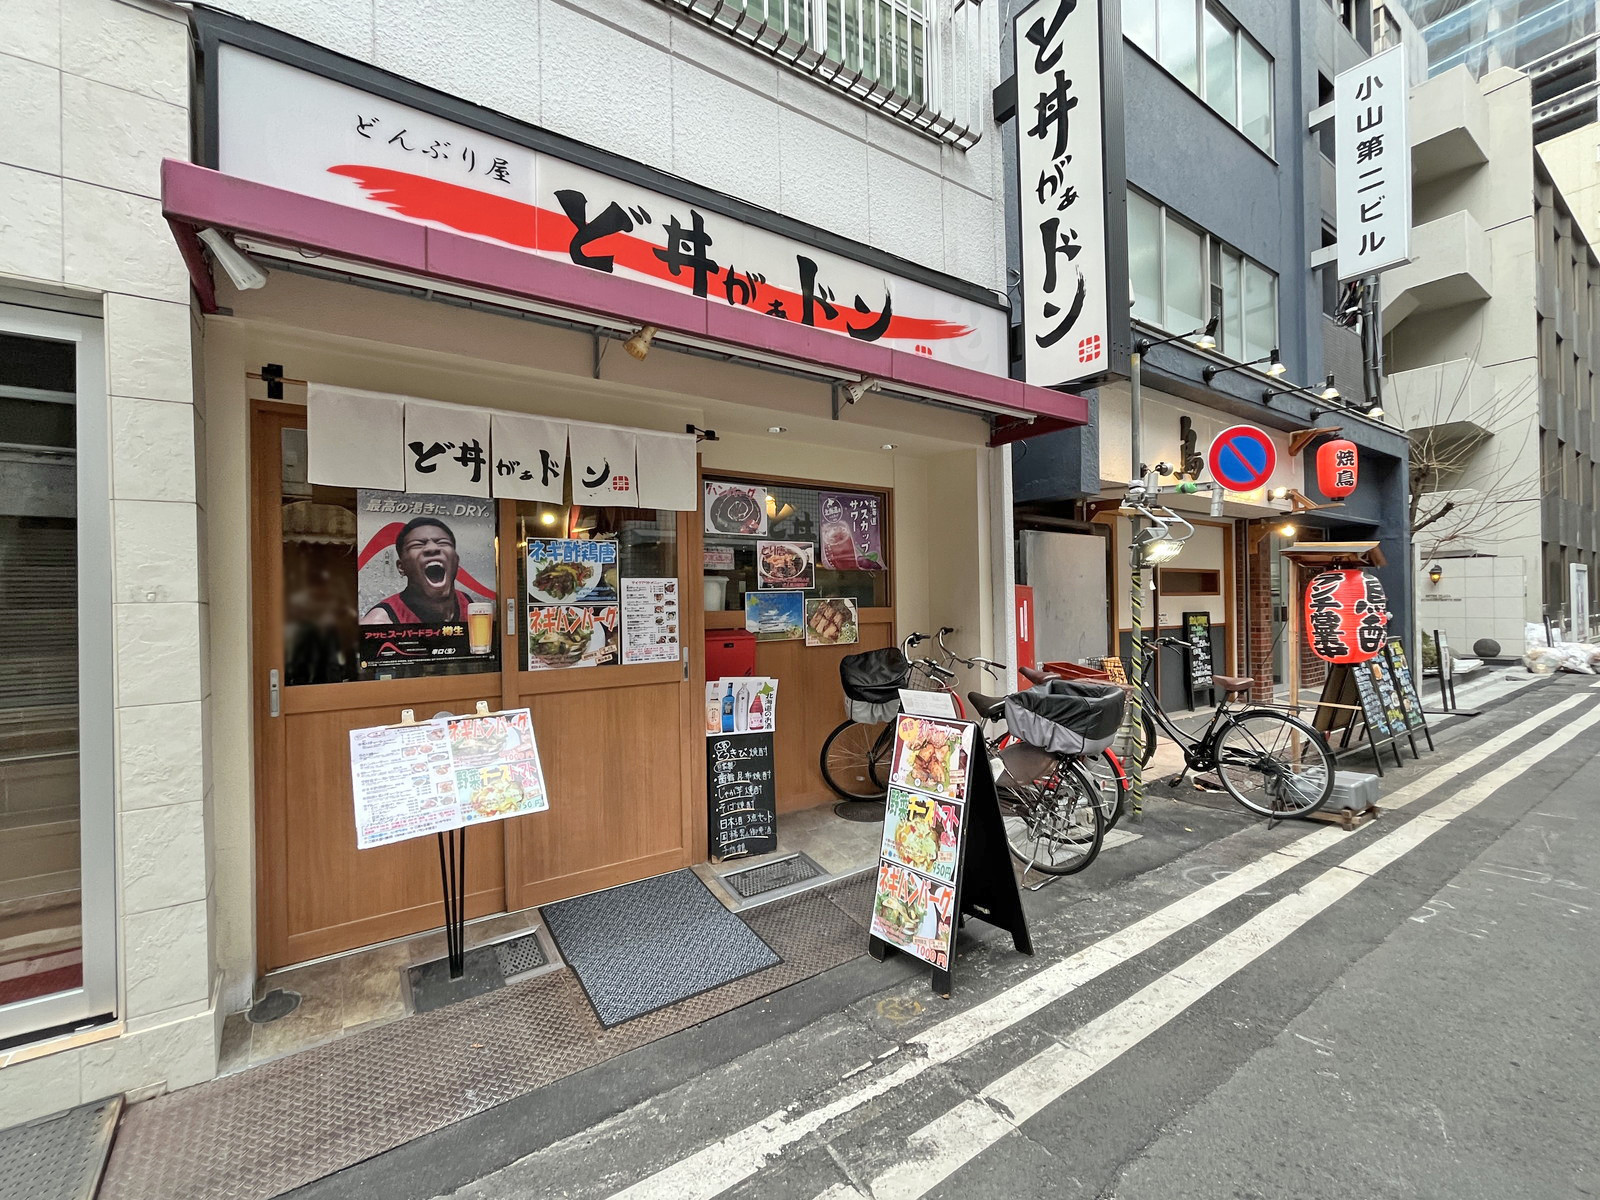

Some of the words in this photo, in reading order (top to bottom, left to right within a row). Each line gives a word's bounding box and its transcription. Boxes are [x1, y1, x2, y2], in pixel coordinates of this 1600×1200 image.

[356, 114, 512, 185] どんぶり屋
[1355, 75, 1386, 256] 小山第二ビル
[1336, 450, 1355, 487] 焼鳥
[849, 500, 859, 532] サワー
[860, 500, 871, 553] ハスカップ
[529, 541, 616, 564] ネギ酢鶏唐
[529, 606, 618, 634] ネギハンバーグ
[1310, 572, 1349, 658] ランチ営業中
[448, 713, 528, 741] ネギハンバーグ
[932, 861, 952, 879] 950円
[880, 863, 953, 921] ネギハンバーグ
[916, 943, 947, 967] 1000円
